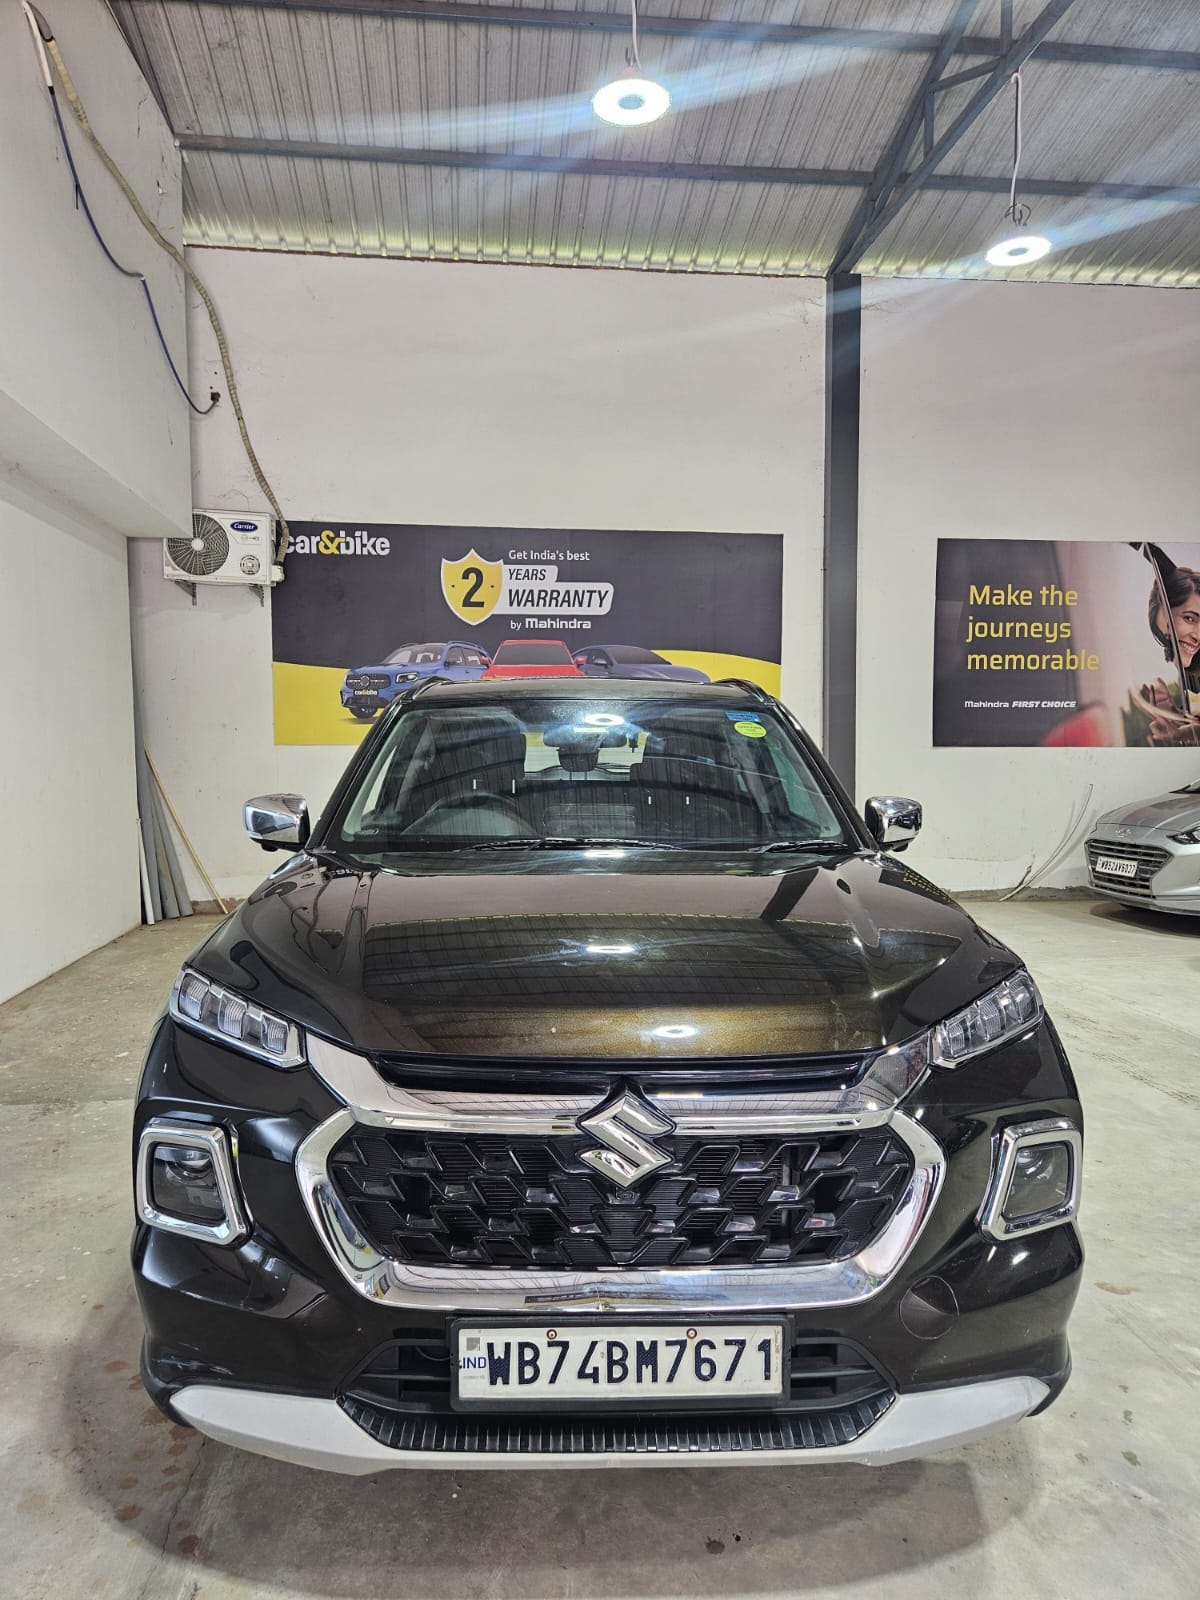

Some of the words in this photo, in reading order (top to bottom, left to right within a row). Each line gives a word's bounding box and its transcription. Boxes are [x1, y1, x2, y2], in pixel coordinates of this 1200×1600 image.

[233, 522, 256, 530] Carrier
[281, 530, 390, 555] car&bike
[508, 550, 528, 560] Get
[530, 550, 565, 560] India's
[566, 550, 590, 561] best
[508, 568, 547, 581] YEARS
[461, 567, 485, 607] 2
[969, 584, 1033, 606] Make
[1040, 584, 1079, 606] the
[508, 589, 609, 608] WARRANTY
[510, 620, 522, 631] by
[525, 618, 592, 629] Mahindra
[966, 615, 1072, 643] journeys
[967, 648, 1100, 670] memorable
[463, 1356, 487, 1369] IND
[487, 1338, 771, 1386] WB74BM7671
